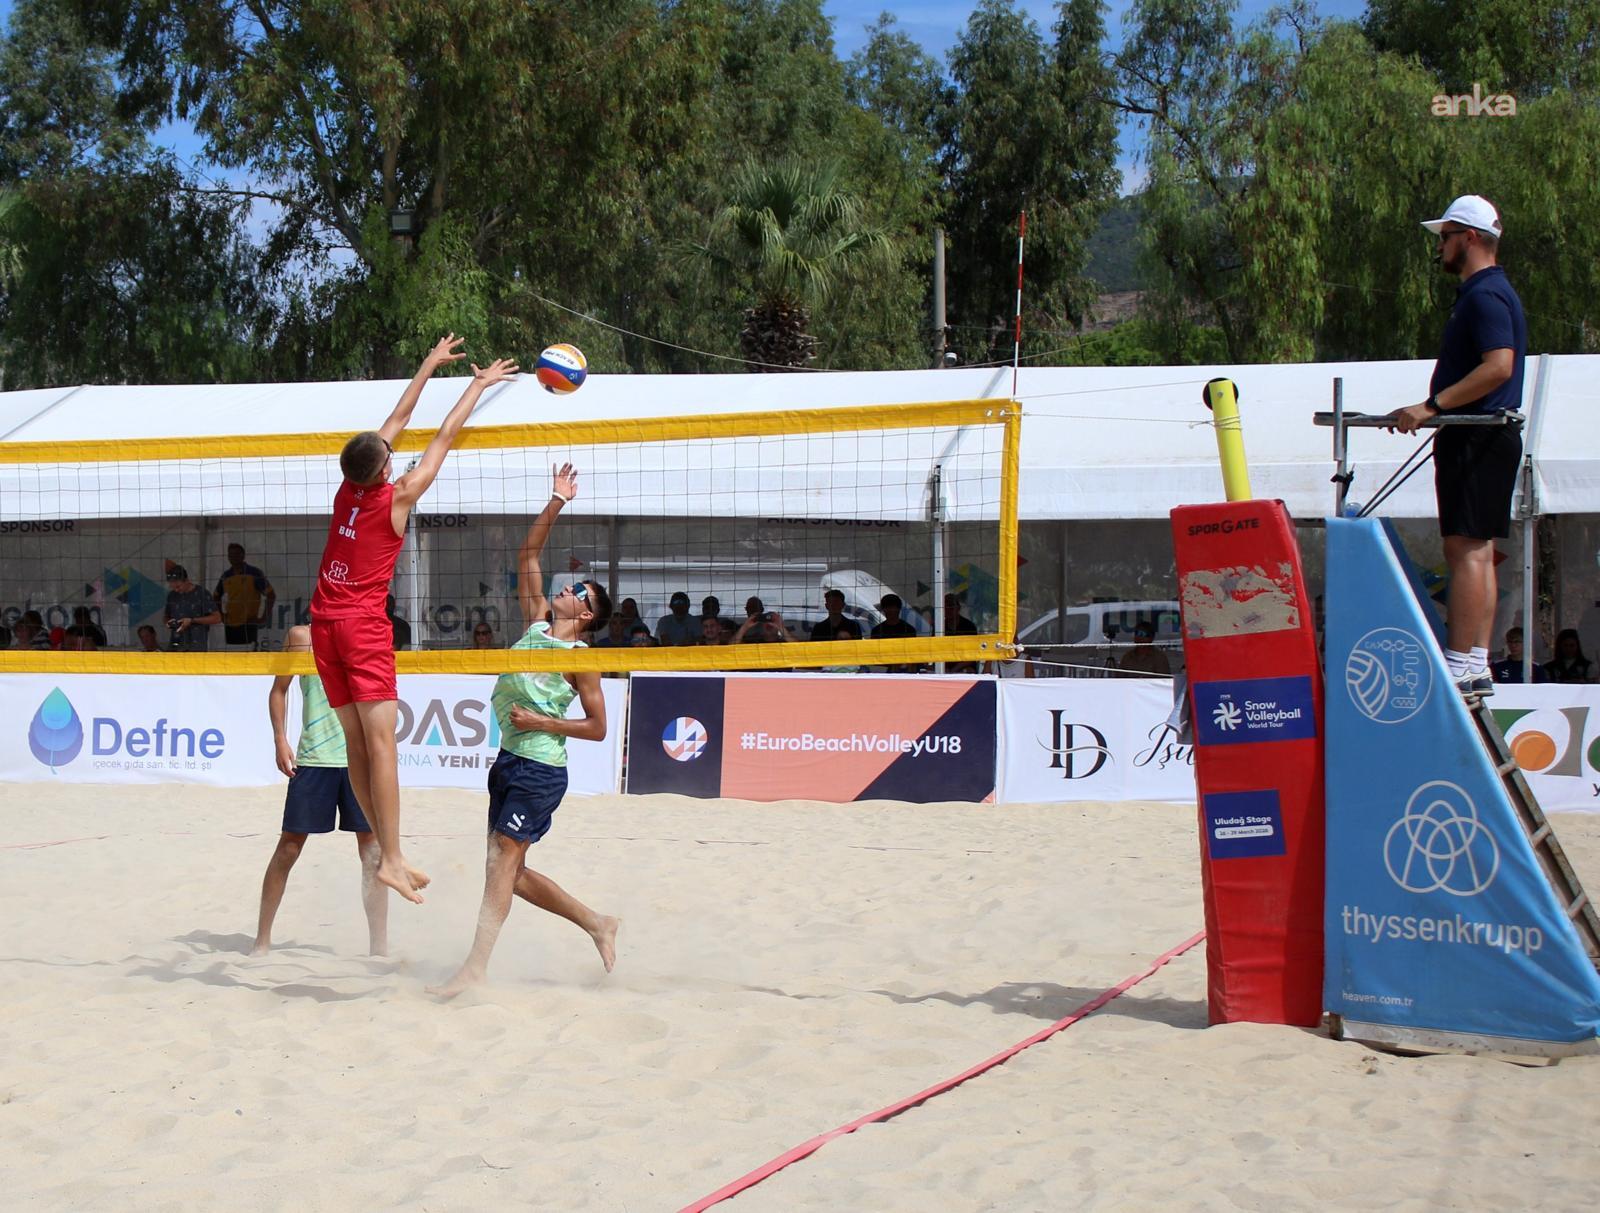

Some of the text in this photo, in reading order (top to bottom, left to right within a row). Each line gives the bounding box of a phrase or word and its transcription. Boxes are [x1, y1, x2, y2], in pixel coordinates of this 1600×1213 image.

[348, 507, 360, 527] 1
[419, 514, 468, 528] NSOR
[0, 520, 75, 533] SPONSOR
[338, 525, 357, 540] BUL
[1187, 518, 1260, 537] SPORGATE
[1244, 700, 1276, 711] Snow
[1245, 708, 1301, 722] Volleyball
[92, 717, 225, 759] Defne
[740, 732, 962, 757] #EuroBeachVolleyU18
[438, 753, 480, 769] YENİ
[1215, 816, 1272, 826] Uludağ Stage
[1341, 905, 1543, 955] thyssenkrupp
[1342, 990, 1414, 1007] heaven.com.tr
